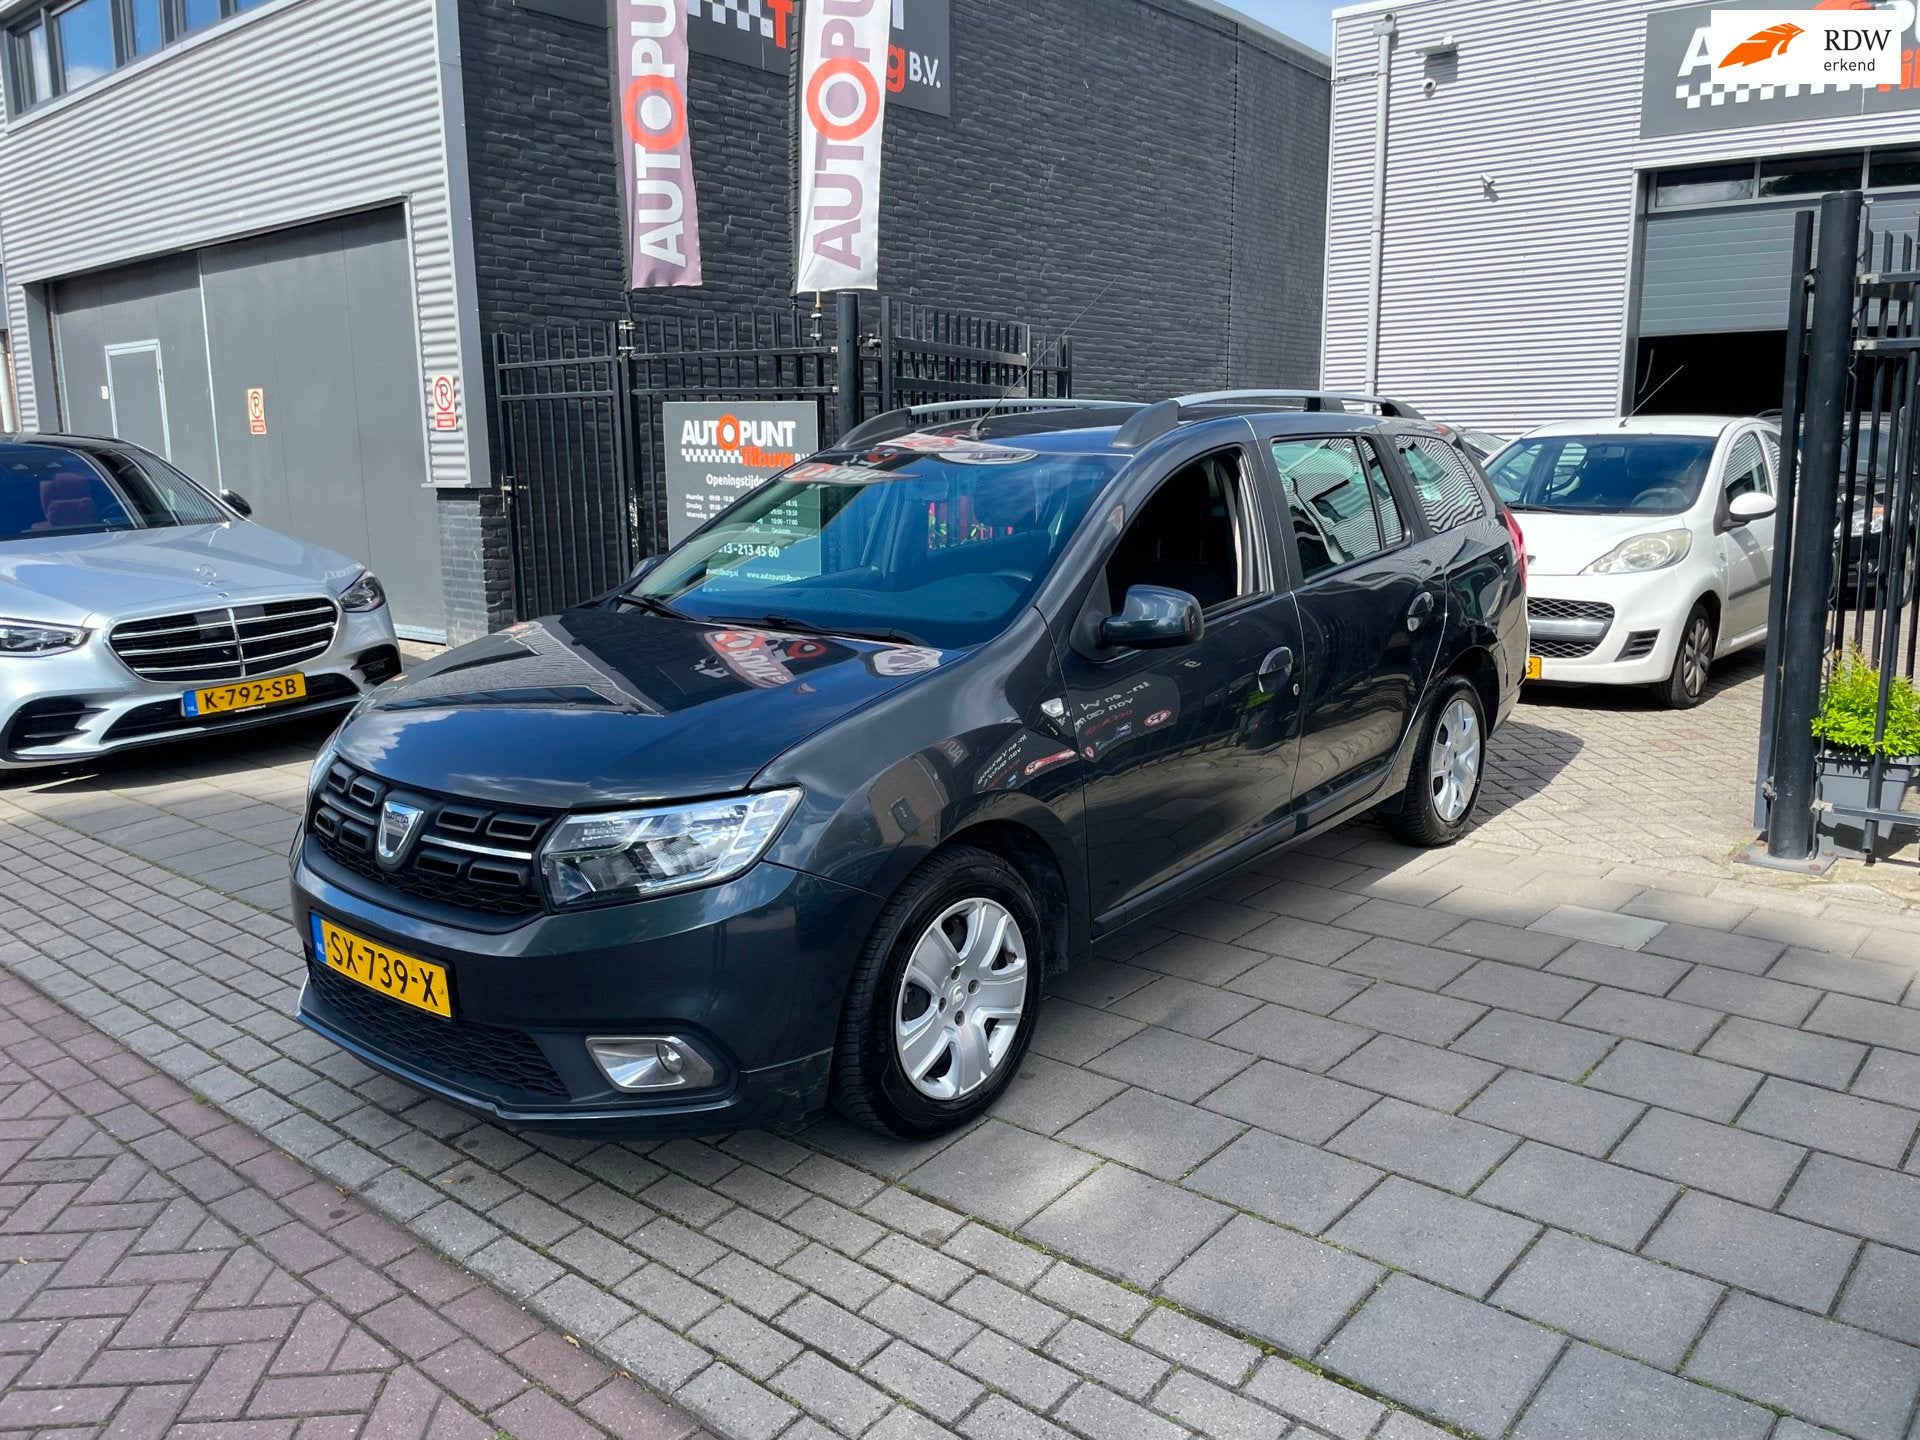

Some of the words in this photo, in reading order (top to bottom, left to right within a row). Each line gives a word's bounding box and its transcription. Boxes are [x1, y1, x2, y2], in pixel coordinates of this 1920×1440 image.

[909, 51, 941, 89] B.V.
[681, 414, 796, 450] AUTOPUNT
[755, 545, 766, 557] 45
[768, 546, 780, 558] 60
[204, 678, 297, 710] K-792-SB
[330, 931, 439, 1007] SX-739-X
